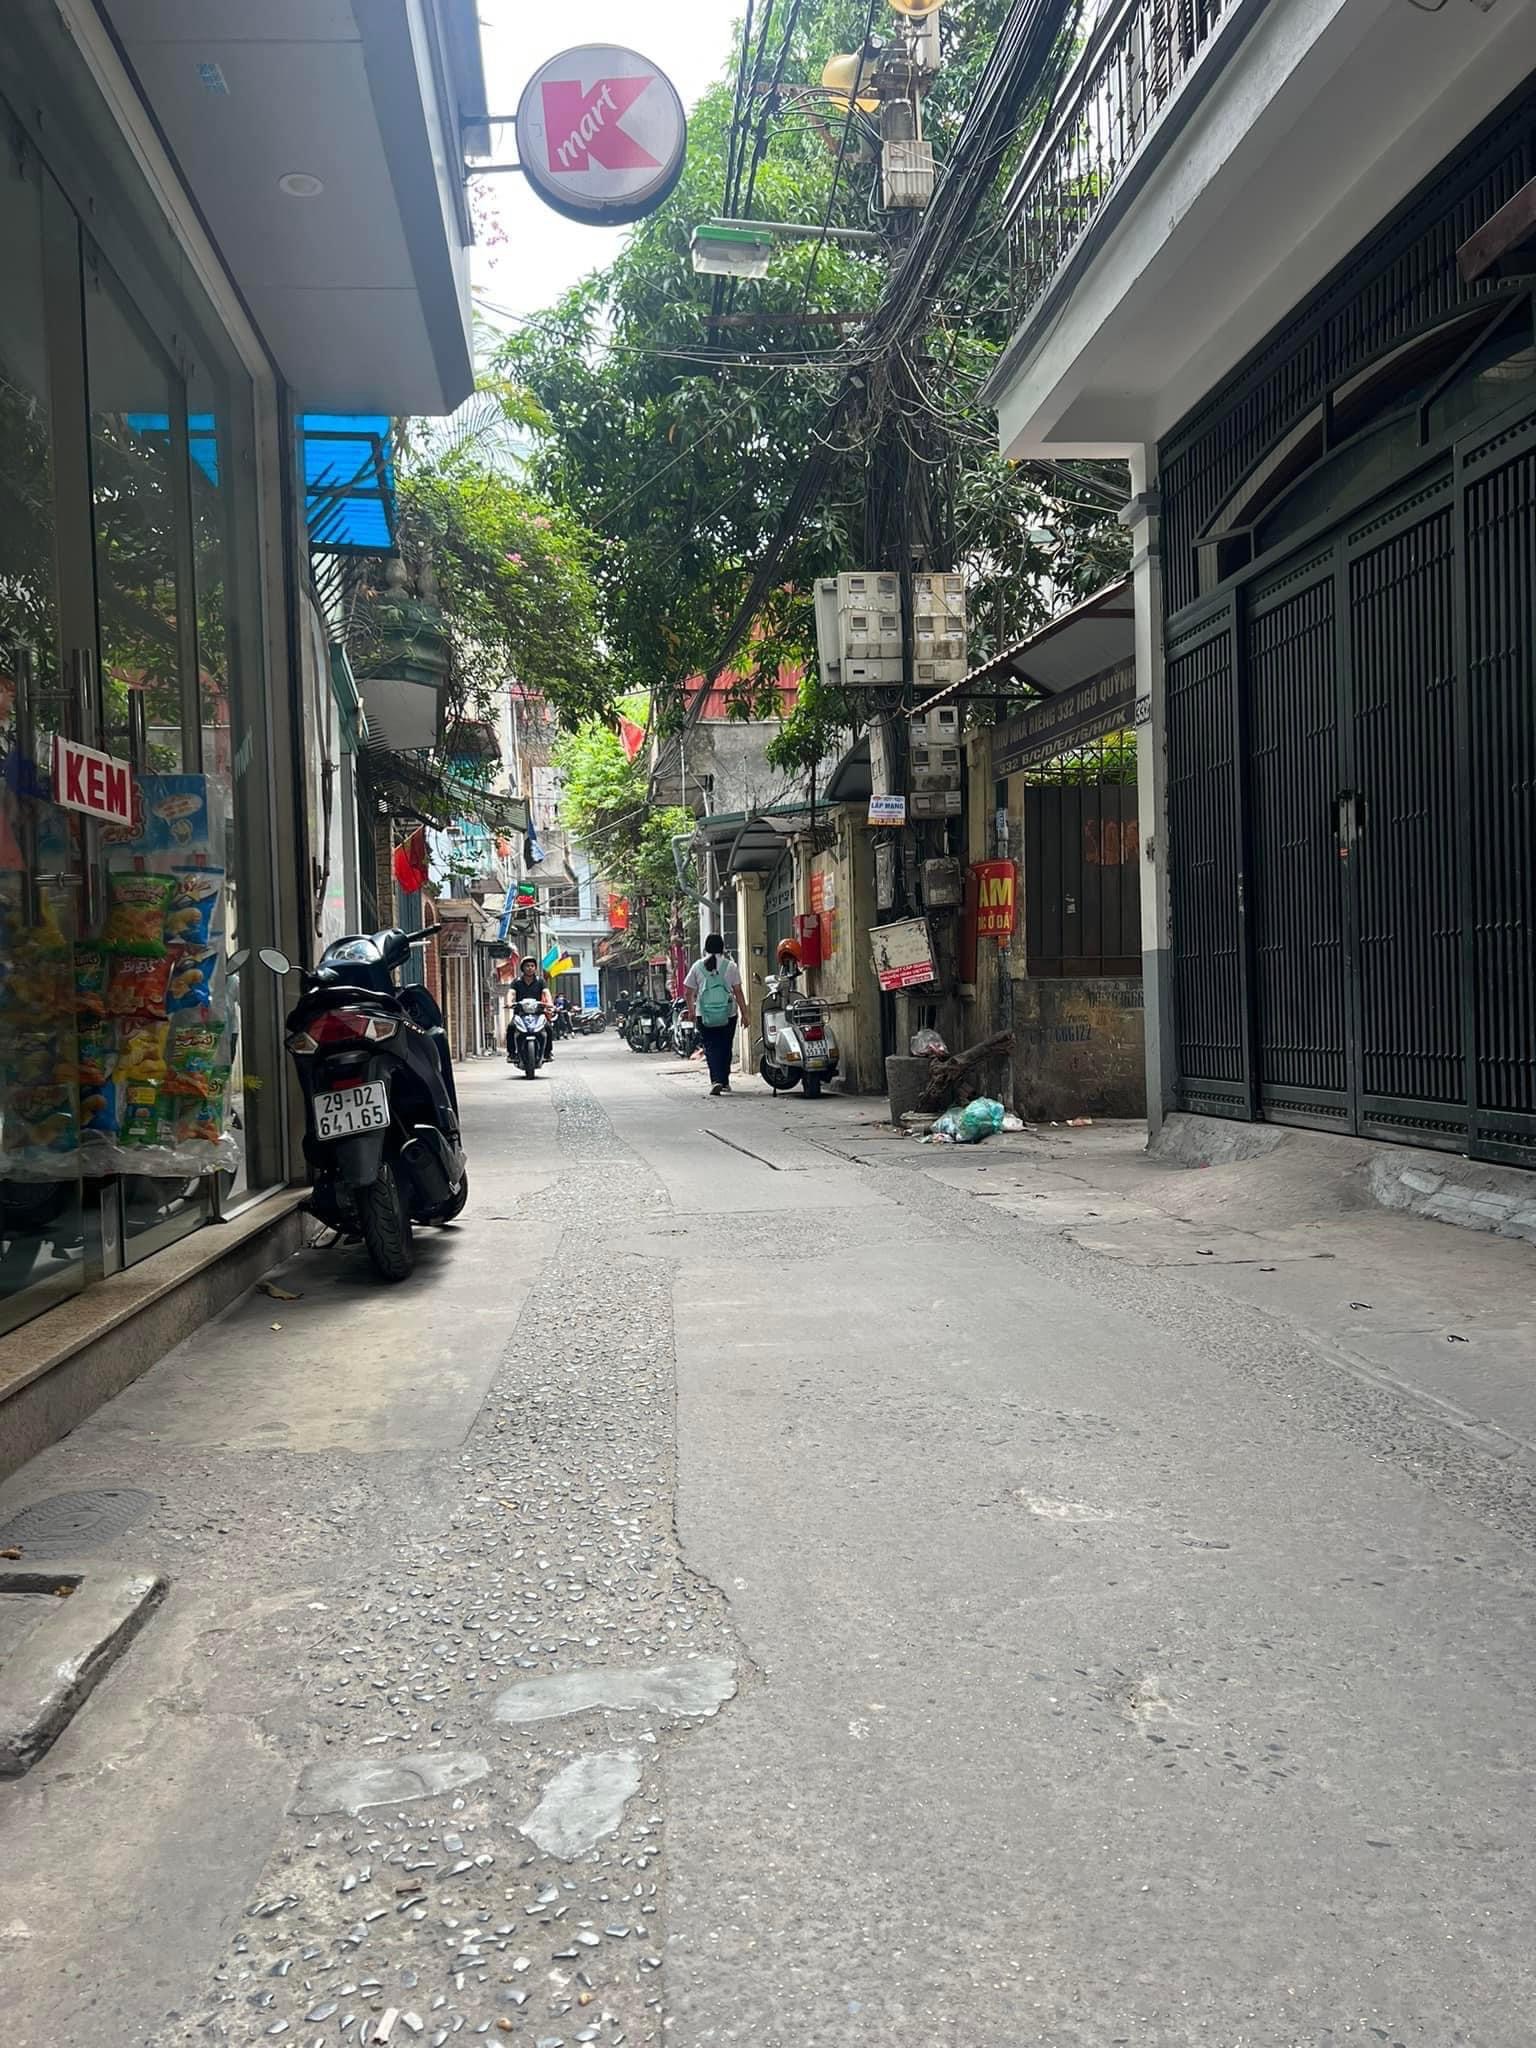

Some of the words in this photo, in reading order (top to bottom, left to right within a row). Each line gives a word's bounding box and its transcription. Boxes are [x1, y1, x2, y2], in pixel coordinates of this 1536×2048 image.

[542, 76, 664, 172] K
[557, 84, 618, 167] mart
[1057, 697, 1075, 721] 332
[1136, 698, 1150, 723] 332
[65, 750, 127, 817] KEM
[323, 1086, 375, 1114] 29-D2
[320, 1105, 383, 1136] 641.65
